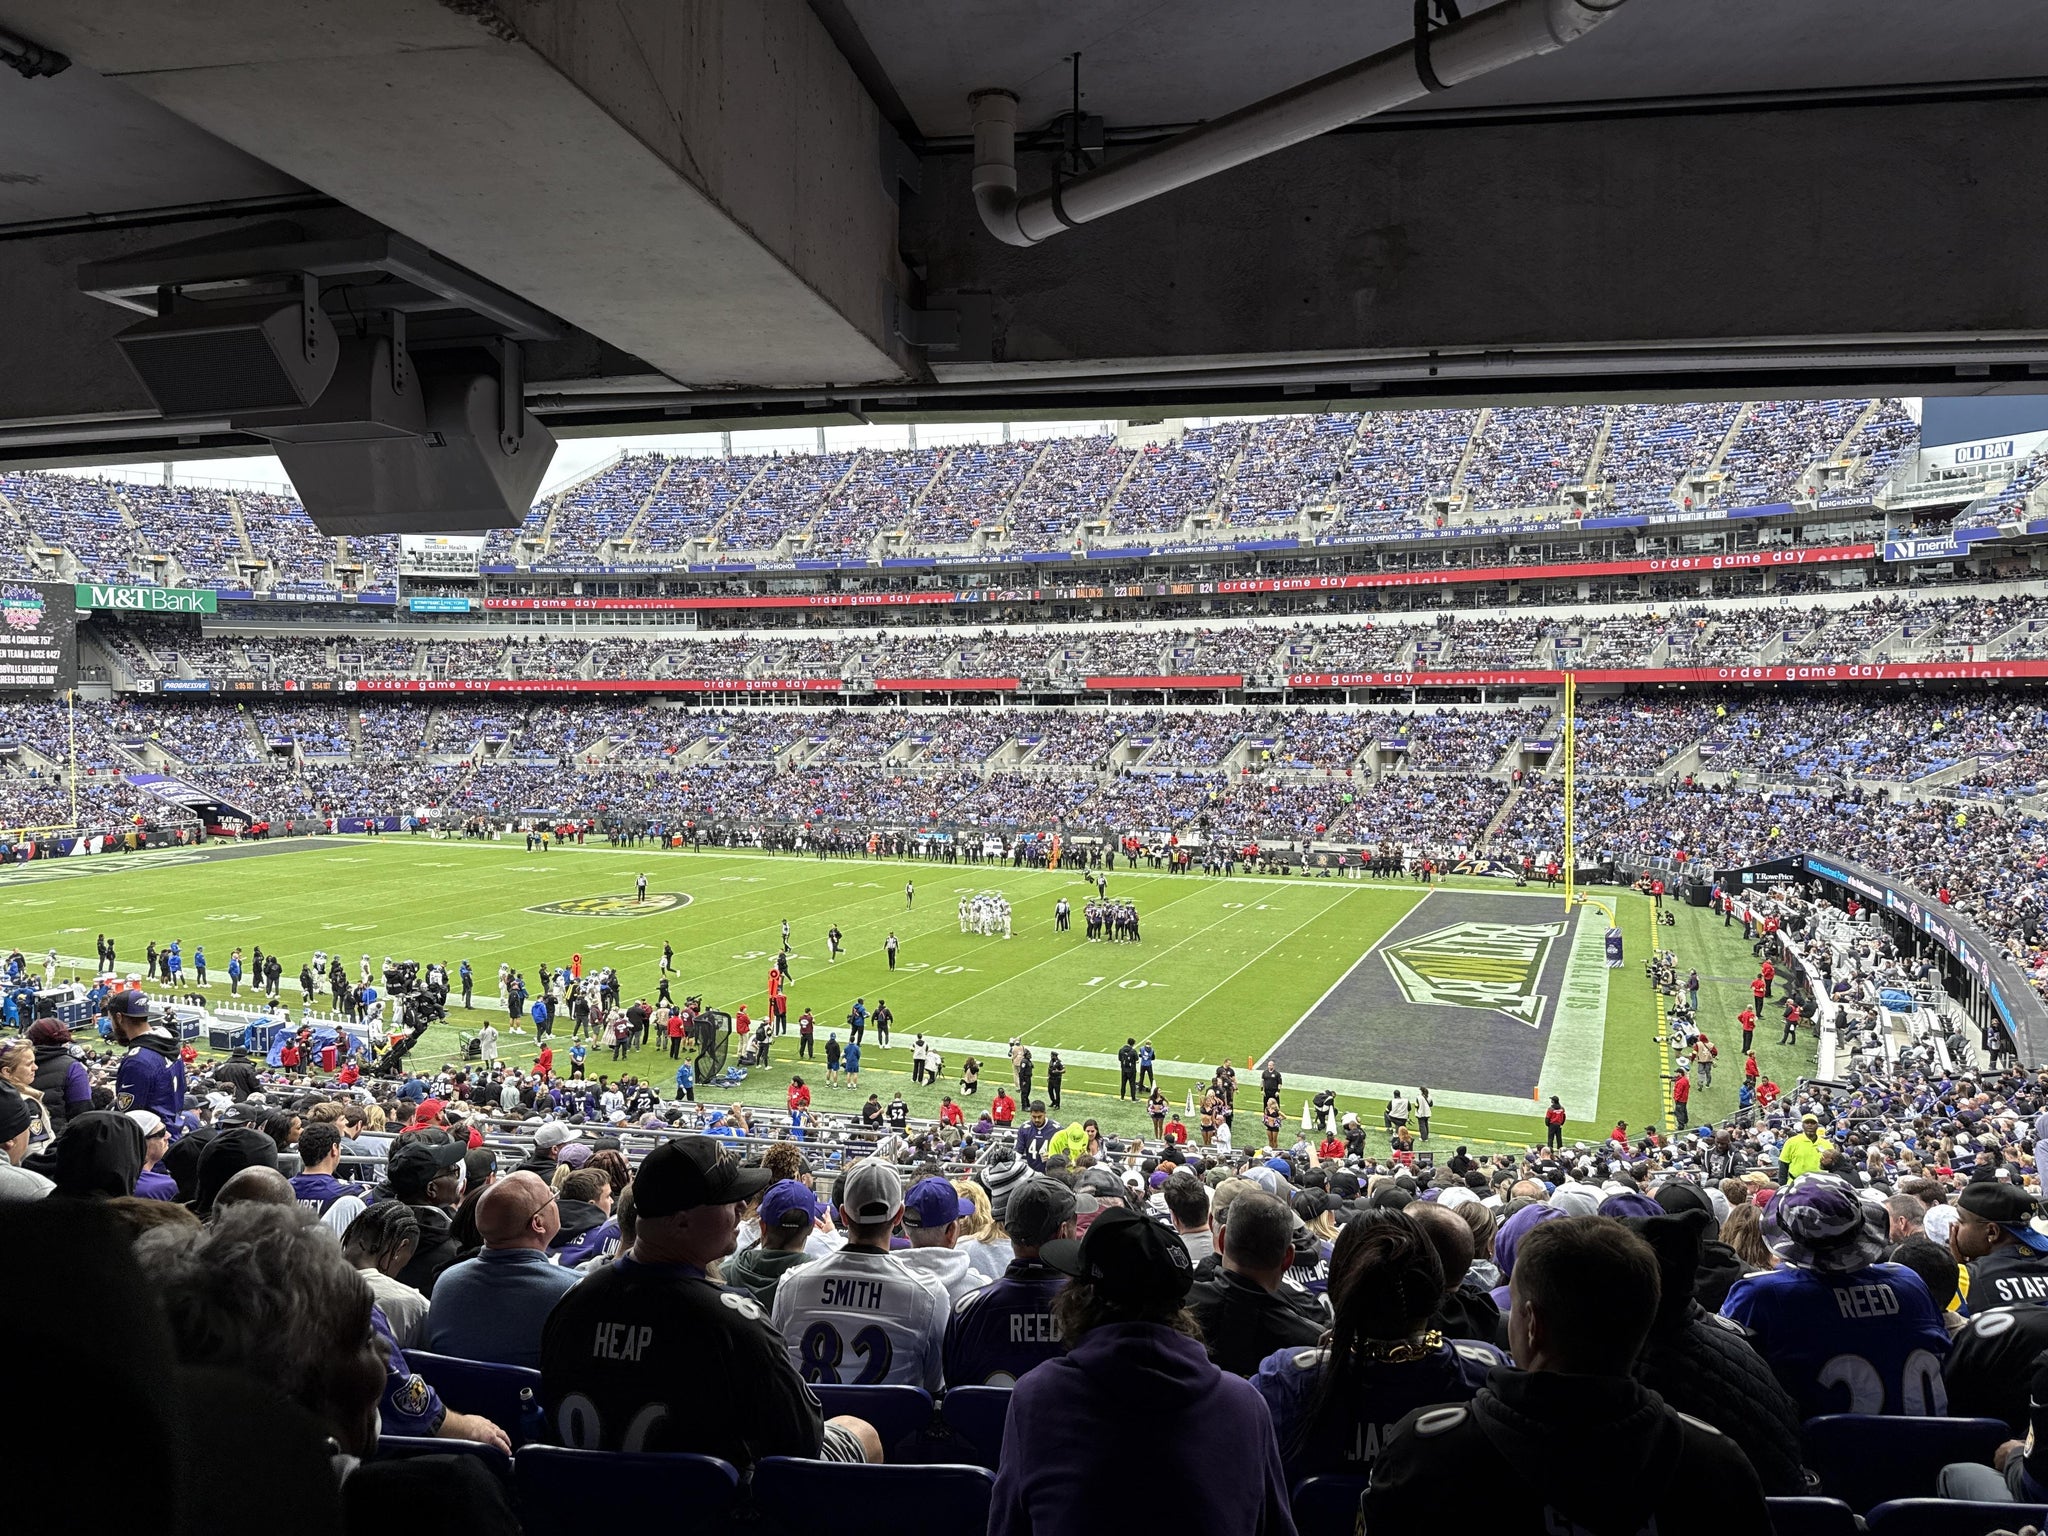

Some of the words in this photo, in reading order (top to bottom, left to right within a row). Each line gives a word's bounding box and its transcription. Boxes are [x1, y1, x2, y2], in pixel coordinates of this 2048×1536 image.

[1958, 448, 1983, 463] OLD
[1984, 442, 2010, 458] BAY
[1819, 500, 1835, 508] RING
[1840, 498, 1870, 506] HONOR
[1365, 534, 1399, 542] CHAMPIONS
[1917, 540, 1958, 551] merritt
[1650, 557, 1700, 570] order
[1713, 554, 1761, 569] game
[1773, 550, 1805, 564] day
[1170, 584, 1194, 595] TIMEOUT
[1200, 583, 1212, 594] 0:24
[1224, 580, 1264, 591] order
[1274, 578, 1310, 591] game
[1320, 576, 1347, 588] day
[1077, 588, 1089, 598] BALL
[1114, 586, 1127, 596] 2:23
[1128, 587, 1139, 596] QTR
[90, 585, 150, 609] M&T
[152, 590, 205, 611] Bank
[487, 599, 525, 607] order
[533, 600, 567, 609] game
[575, 599, 598, 609] day
[810, 596, 843, 604] order
[851, 595, 882, 606] game
[889, 594, 911, 605] day
[16, 636, 40, 645] CHANGE
[7, 649, 24, 658] TEAM
[30, 650, 46, 659] ACCE
[22, 665, 58, 674] ELEMENTARY
[1719, 667, 1772, 678] order
[1786, 666, 1836, 680] game
[1849, 664, 1885, 678] day
[16, 675, 39, 684] SCHOOL
[39, 675, 55, 684] CLUB
[368, 680, 409, 689] order
[419, 681, 456, 691] game
[465, 679, 491, 690] day
[704, 680, 738, 689] order
[746, 681, 778, 691] game
[786, 679, 808, 690] day
[1331, 675, 1373, 685] game
[1383, 673, 1413, 684] day
[443, 931, 506, 941] 50
[897, 962, 965, 975] 20
[1078, 976, 1150, 989] 10
[1565, 996, 1599, 1010] US
[637, 1098, 651, 1109] 22
[891, 1108, 904, 1119] 52
[1291, 1259, 1330, 1285] DREWS
[821, 1278, 883, 1309] SMITH
[1832, 1283, 1900, 1319] REED
[1010, 1313, 1062, 1343] REED
[593, 1322, 653, 1362] HEAP
[800, 1320, 893, 1384] 82
